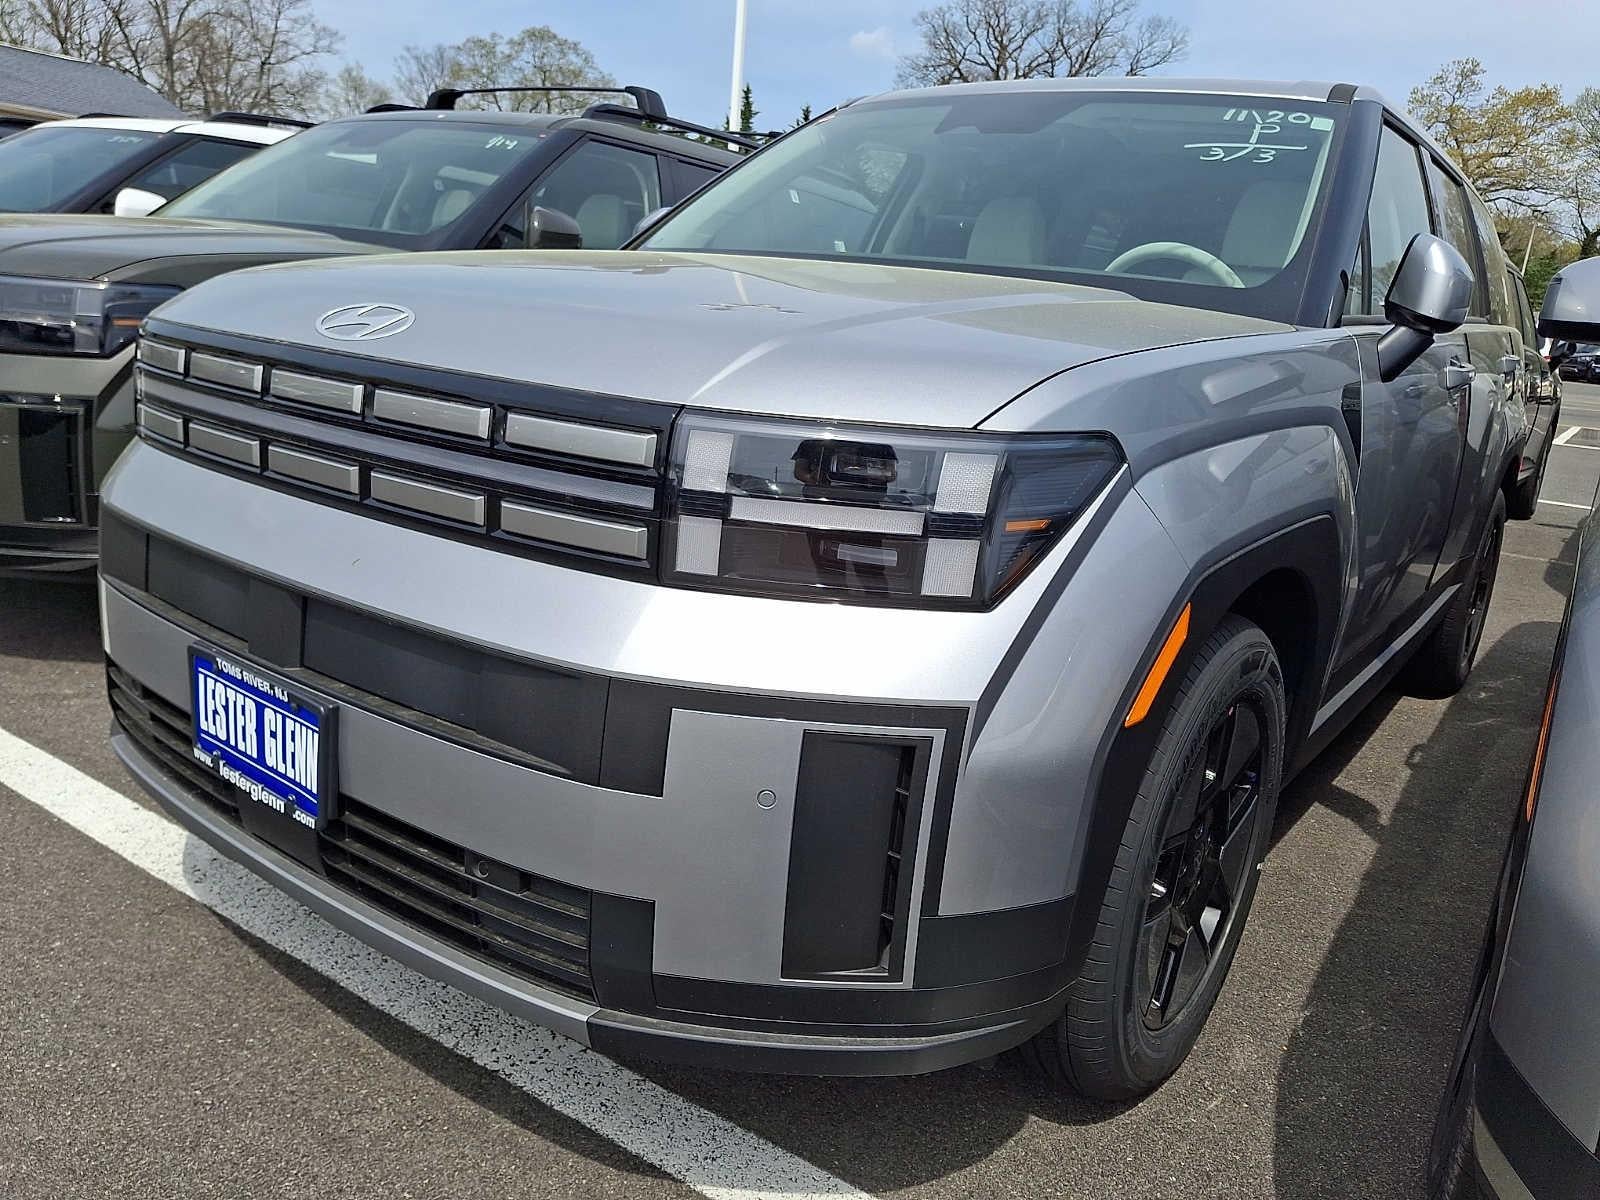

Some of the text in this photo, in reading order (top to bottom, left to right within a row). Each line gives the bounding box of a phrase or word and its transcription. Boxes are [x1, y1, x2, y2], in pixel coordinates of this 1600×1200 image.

[216, 657, 242, 680] TOMS
[274, 685, 289, 703] NJ
[198, 672, 320, 795] LESTER GLENN
